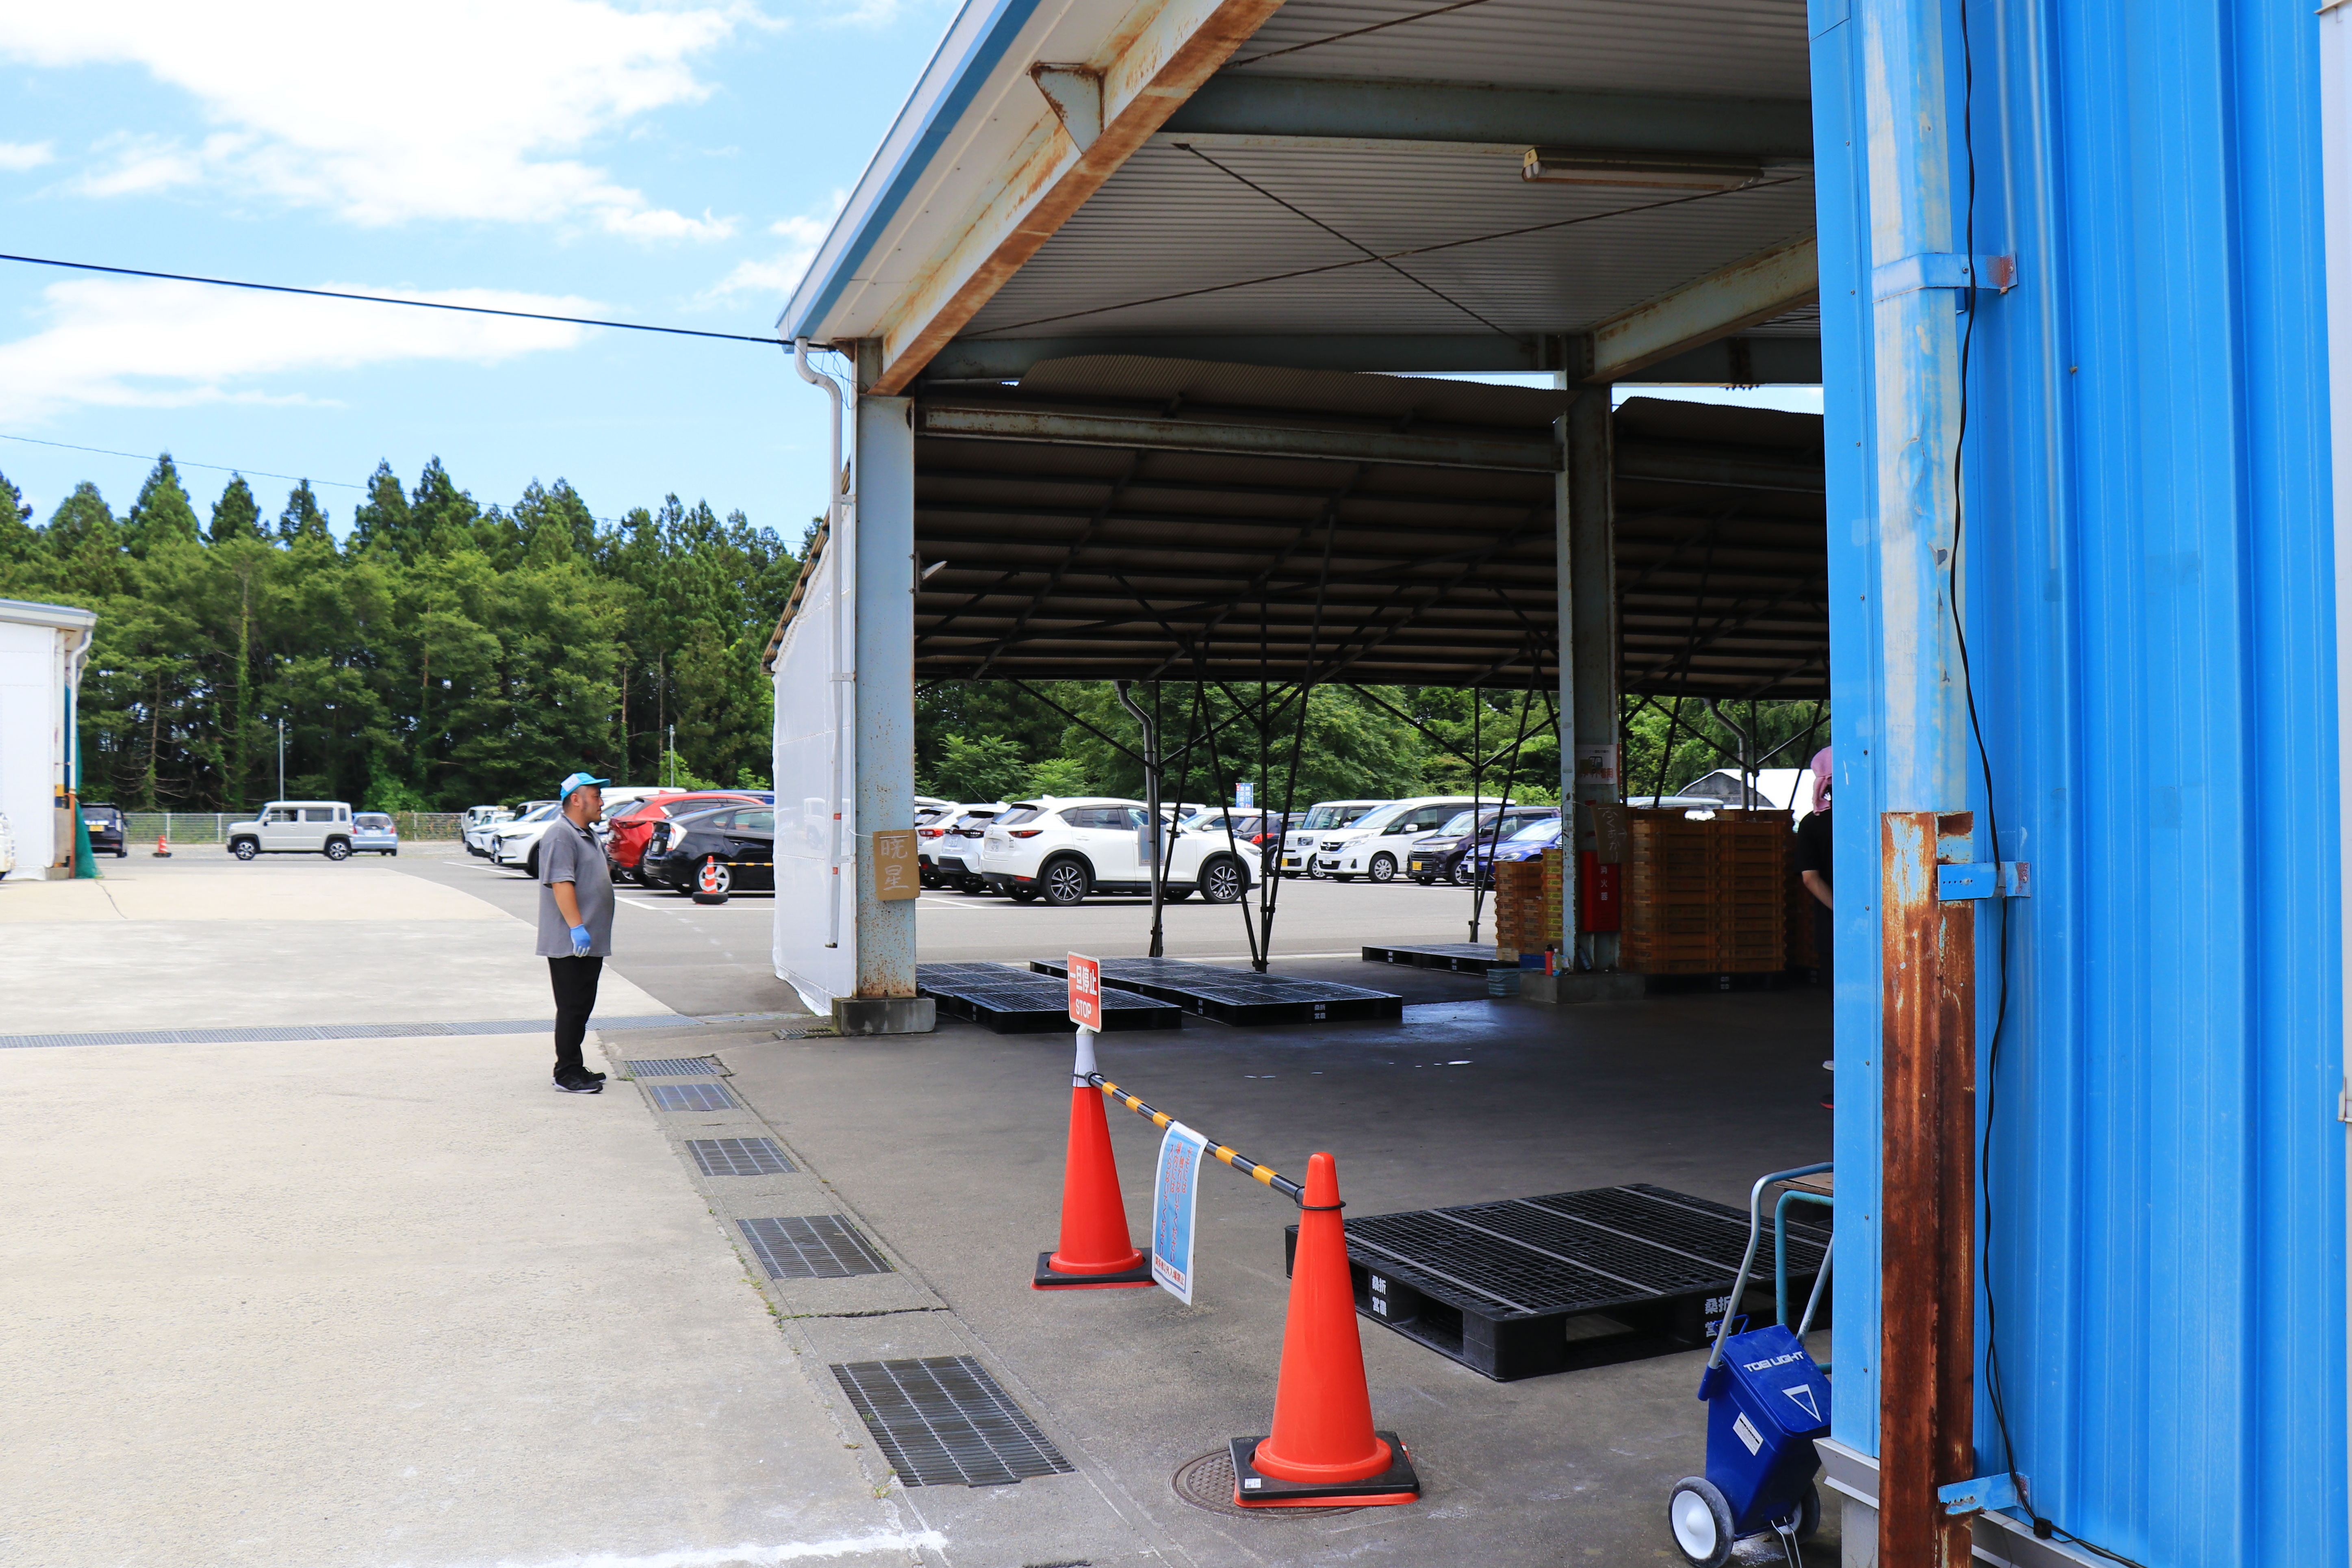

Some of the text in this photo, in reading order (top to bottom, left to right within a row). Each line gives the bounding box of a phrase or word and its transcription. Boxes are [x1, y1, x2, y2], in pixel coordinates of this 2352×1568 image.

[1070, 965, 1098, 995] 一旦停止
[1075, 998, 1091, 1019] STOP
[1170, 1141, 1183, 1193] 場内には
[1159, 1144, 1174, 1256] 入らないでください
[1170, 1156, 1185, 1262] 触れないでください
[1155, 1256, 1184, 1286] 関係者以外入場禁止
[1372, 1275, 1386, 1295] 桑折
[1743, 1351, 1804, 1372] TOEI LIGHT
